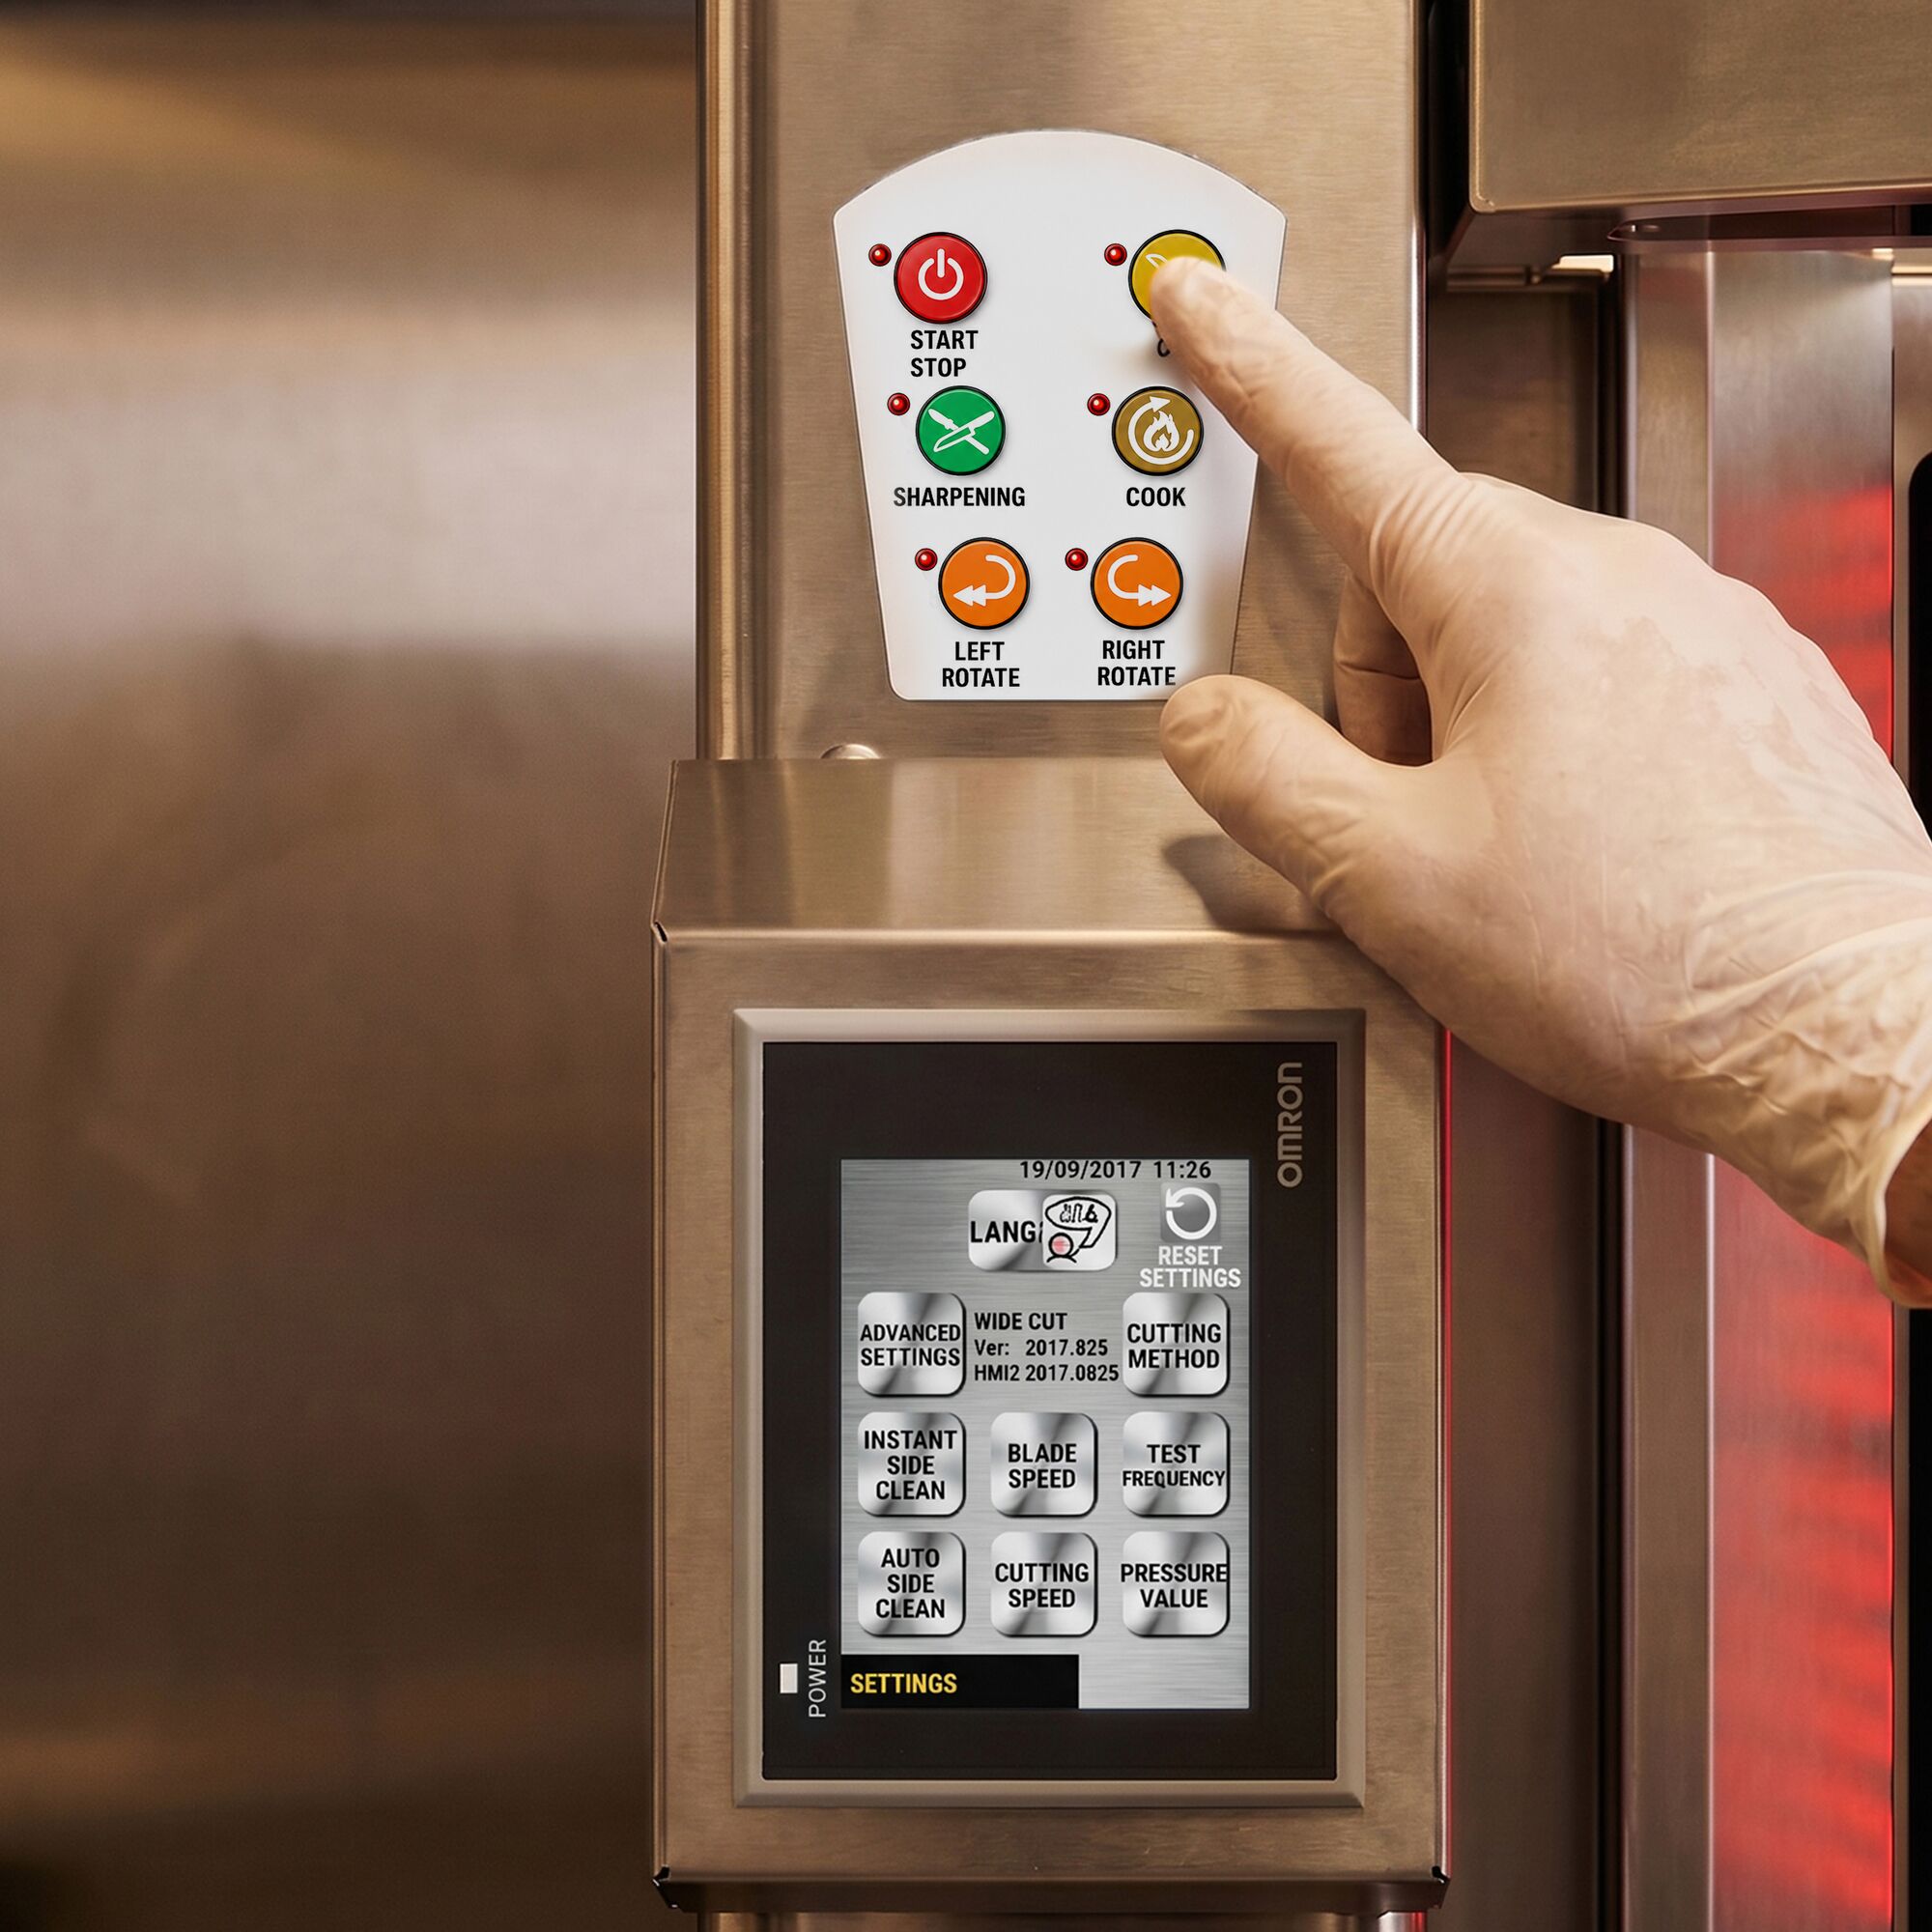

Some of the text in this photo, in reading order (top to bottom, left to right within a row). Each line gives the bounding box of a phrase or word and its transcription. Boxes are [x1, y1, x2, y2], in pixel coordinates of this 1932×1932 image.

[910, 329, 979, 350] START
[910, 356, 967, 378] STOP
[894, 486, 1026, 507] SHARPENING
[1125, 486, 1186, 507] COOK
[954, 640, 1006, 662] LEFT
[1102, 639, 1166, 660] RIGHT
[942, 668, 1020, 688] ROTATE
[1097, 666, 1177, 687] ROTATE
[1019, 1160, 1212, 1179] 19/09/2017 11:26
[1157, 1245, 1223, 1265] RESET
[1139, 1267, 1242, 1289] SETTINGS
[974, 1312, 1068, 1331] WIDE CUT
[860, 1323, 961, 1343] ADVANCED
[1126, 1323, 1222, 1344] CUTTING
[860, 1347, 961, 1367] SETTINGS
[974, 1339, 1109, 1356] Ver: 2017.825
[1127, 1349, 1220, 1369] METHOD
[974, 1364, 1120, 1381] HMI2 2017.0825
[864, 1430, 958, 1450] INSTANT
[1008, 1443, 1078, 1463] BLADE
[1146, 1443, 1202, 1463] TEST
[886, 1455, 936, 1475] SIDE
[1008, 1468, 1076, 1489] SPEED
[1122, 1469, 1227, 1490] FREQUENCY
[874, 1480, 947, 1500] CLEAN
[880, 1548, 941, 1569] AUTO
[994, 1562, 1090, 1583] CUTTING
[1120, 1562, 1229, 1583] PRESSURE
[886, 1574, 935, 1594] SIDE
[1008, 1588, 1076, 1608] SPEED
[1139, 1588, 1209, 1608] VALUE
[874, 1599, 947, 1619] CLEAN
[808, 1639, 827, 1718] POWER
[850, 1672, 958, 1693] SETTINGS
